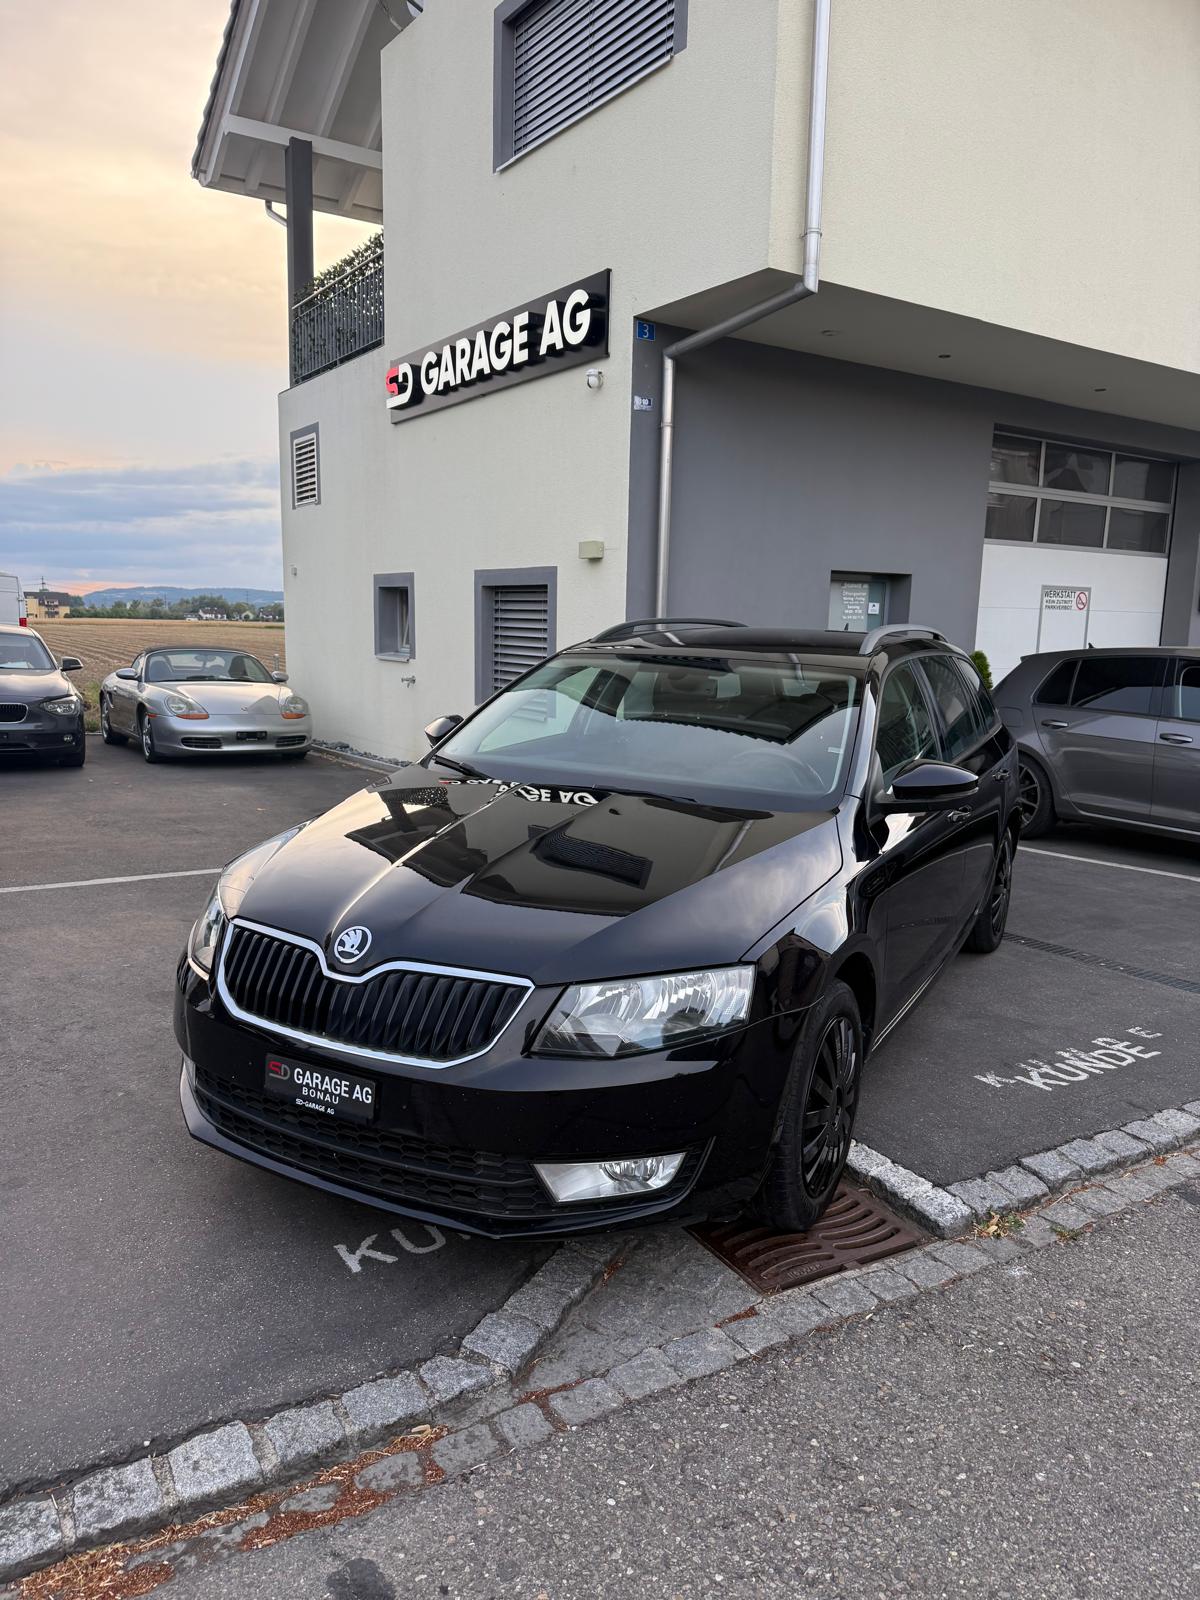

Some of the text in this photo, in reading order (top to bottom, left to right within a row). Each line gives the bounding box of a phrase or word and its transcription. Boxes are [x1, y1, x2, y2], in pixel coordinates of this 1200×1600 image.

[385, 288, 591, 409] SD GARAGE AG
[642, 323, 650, 338] 3
[1044, 590, 1076, 599] WERKSTATT
[1016, 1040, 1162, 1091] KUNDE
[294, 1067, 350, 1098] GARAGE
[352, 1084, 372, 1104] AG
[302, 1087, 339, 1104] BONAU
[333, 1223, 448, 1273] KU
